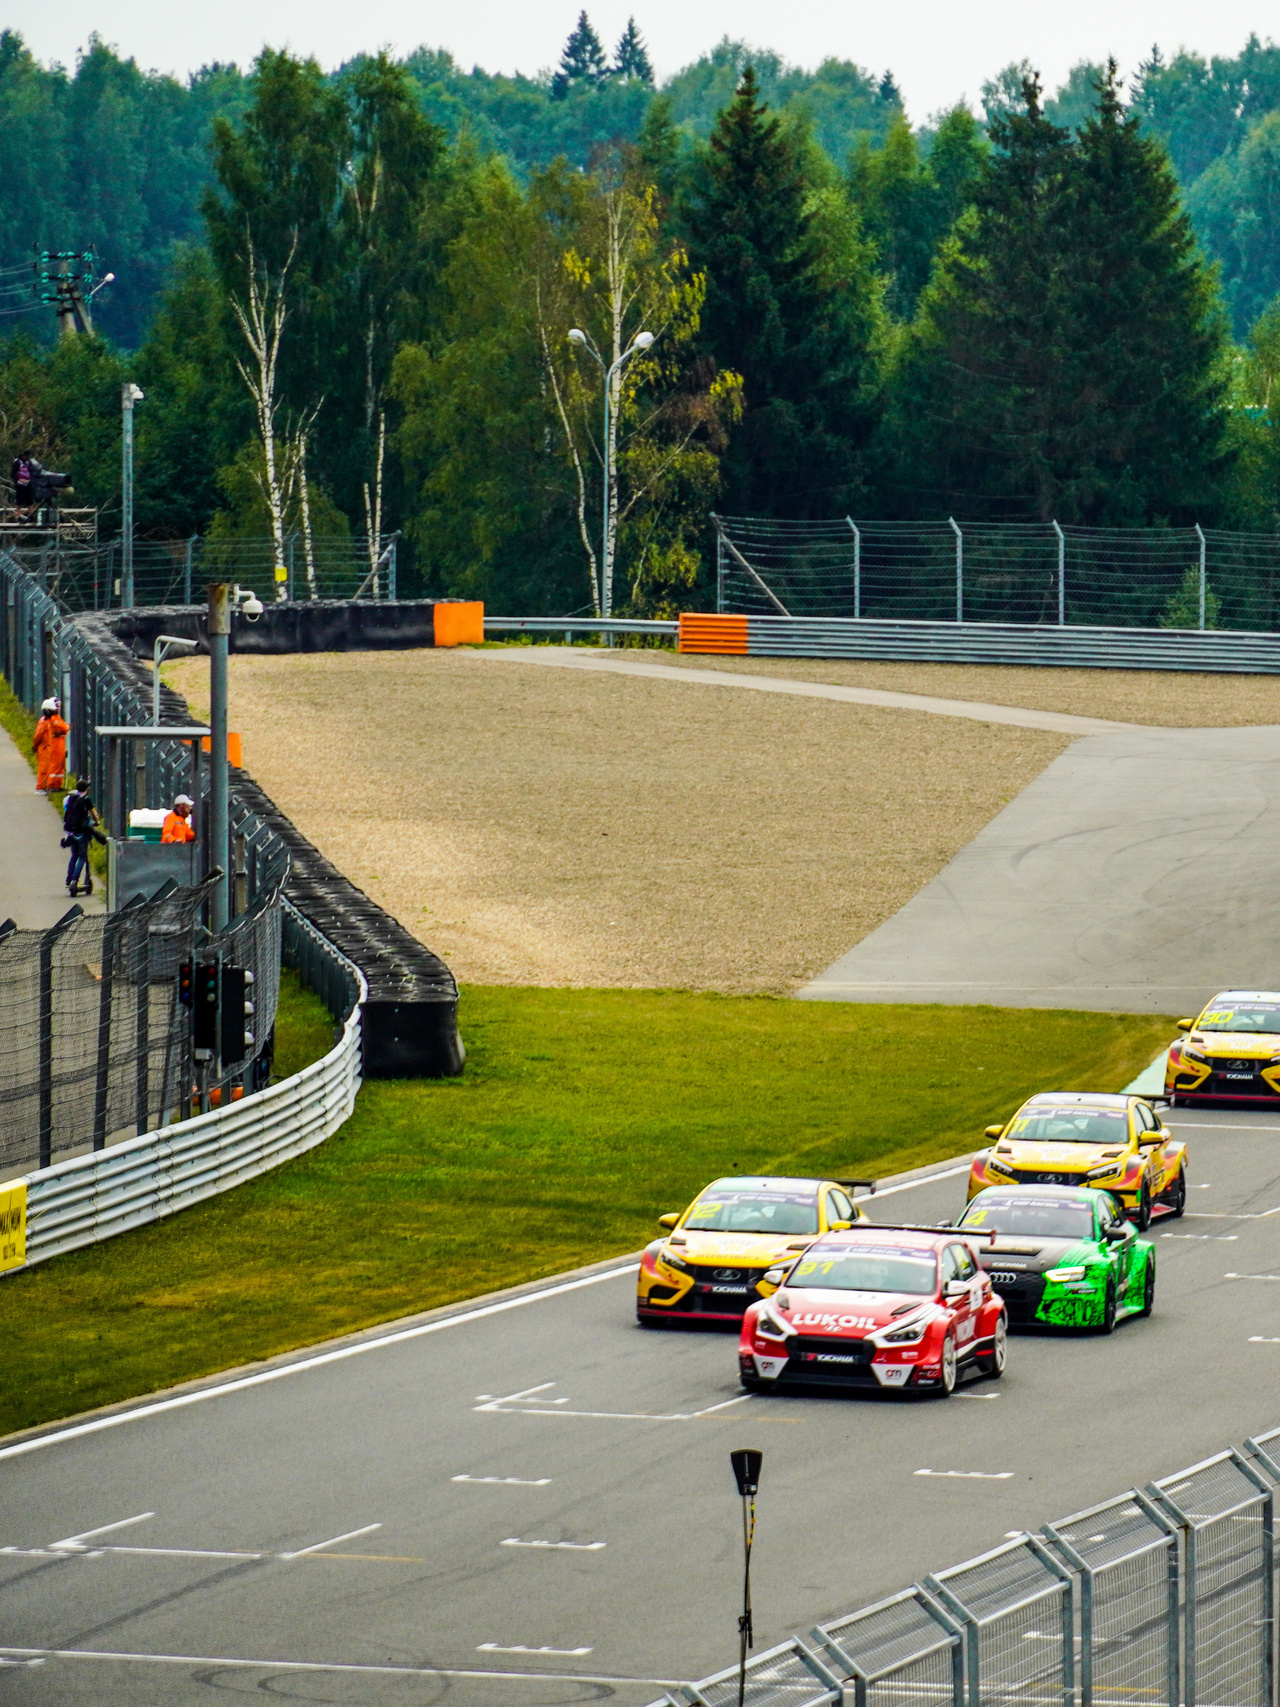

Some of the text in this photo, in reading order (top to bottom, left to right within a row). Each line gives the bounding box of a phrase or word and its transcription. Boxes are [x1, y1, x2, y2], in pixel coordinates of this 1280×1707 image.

[1199, 1012, 1234, 1026] 30
[692, 1203, 723, 1219] 12
[963, 1210, 988, 1226] 4
[796, 1261, 834, 1275] 91
[791, 1313, 878, 1330] LUKOIL
